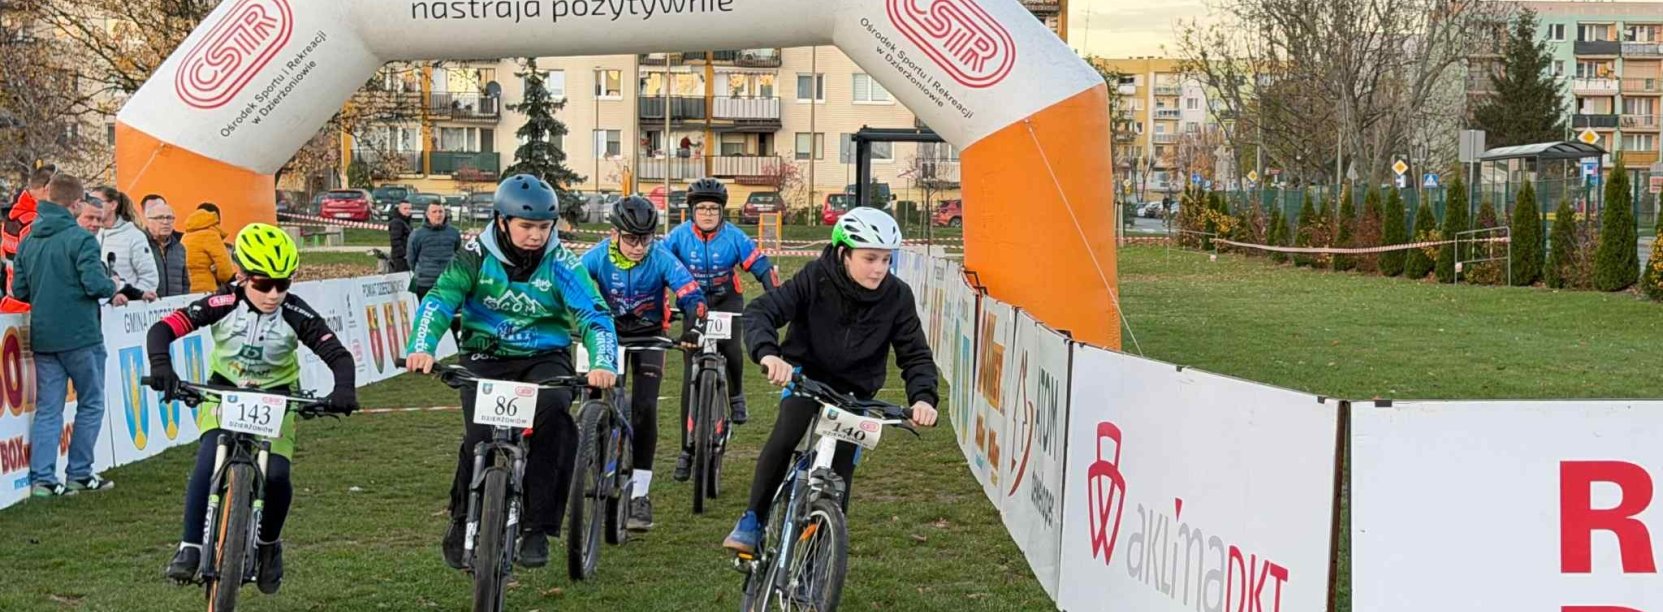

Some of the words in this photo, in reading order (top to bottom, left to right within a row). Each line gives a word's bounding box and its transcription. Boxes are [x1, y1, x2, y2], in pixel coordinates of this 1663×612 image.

[411, 0, 541, 23] nastraja
[552, 0, 734, 22] pozytywnie
[220, 102, 258, 138] Ośrodek
[253, 72, 285, 103] Sportu
[286, 29, 328, 72] Rekreacji
[251, 115, 262, 126] w
[258, 59, 317, 117] Dzierżoniowie
[860, 17, 896, 53] Ośrodek
[896, 48, 928, 80] Sportu
[932, 81, 974, 120] Rekreacji
[875, 46, 884, 56] w
[884, 52, 944, 109] Dzierżoniowie
[237, 403, 272, 425] 143
[495, 395, 518, 417] 86
[832, 422, 866, 441] 140
[1036, 366, 1059, 462] ATOM
